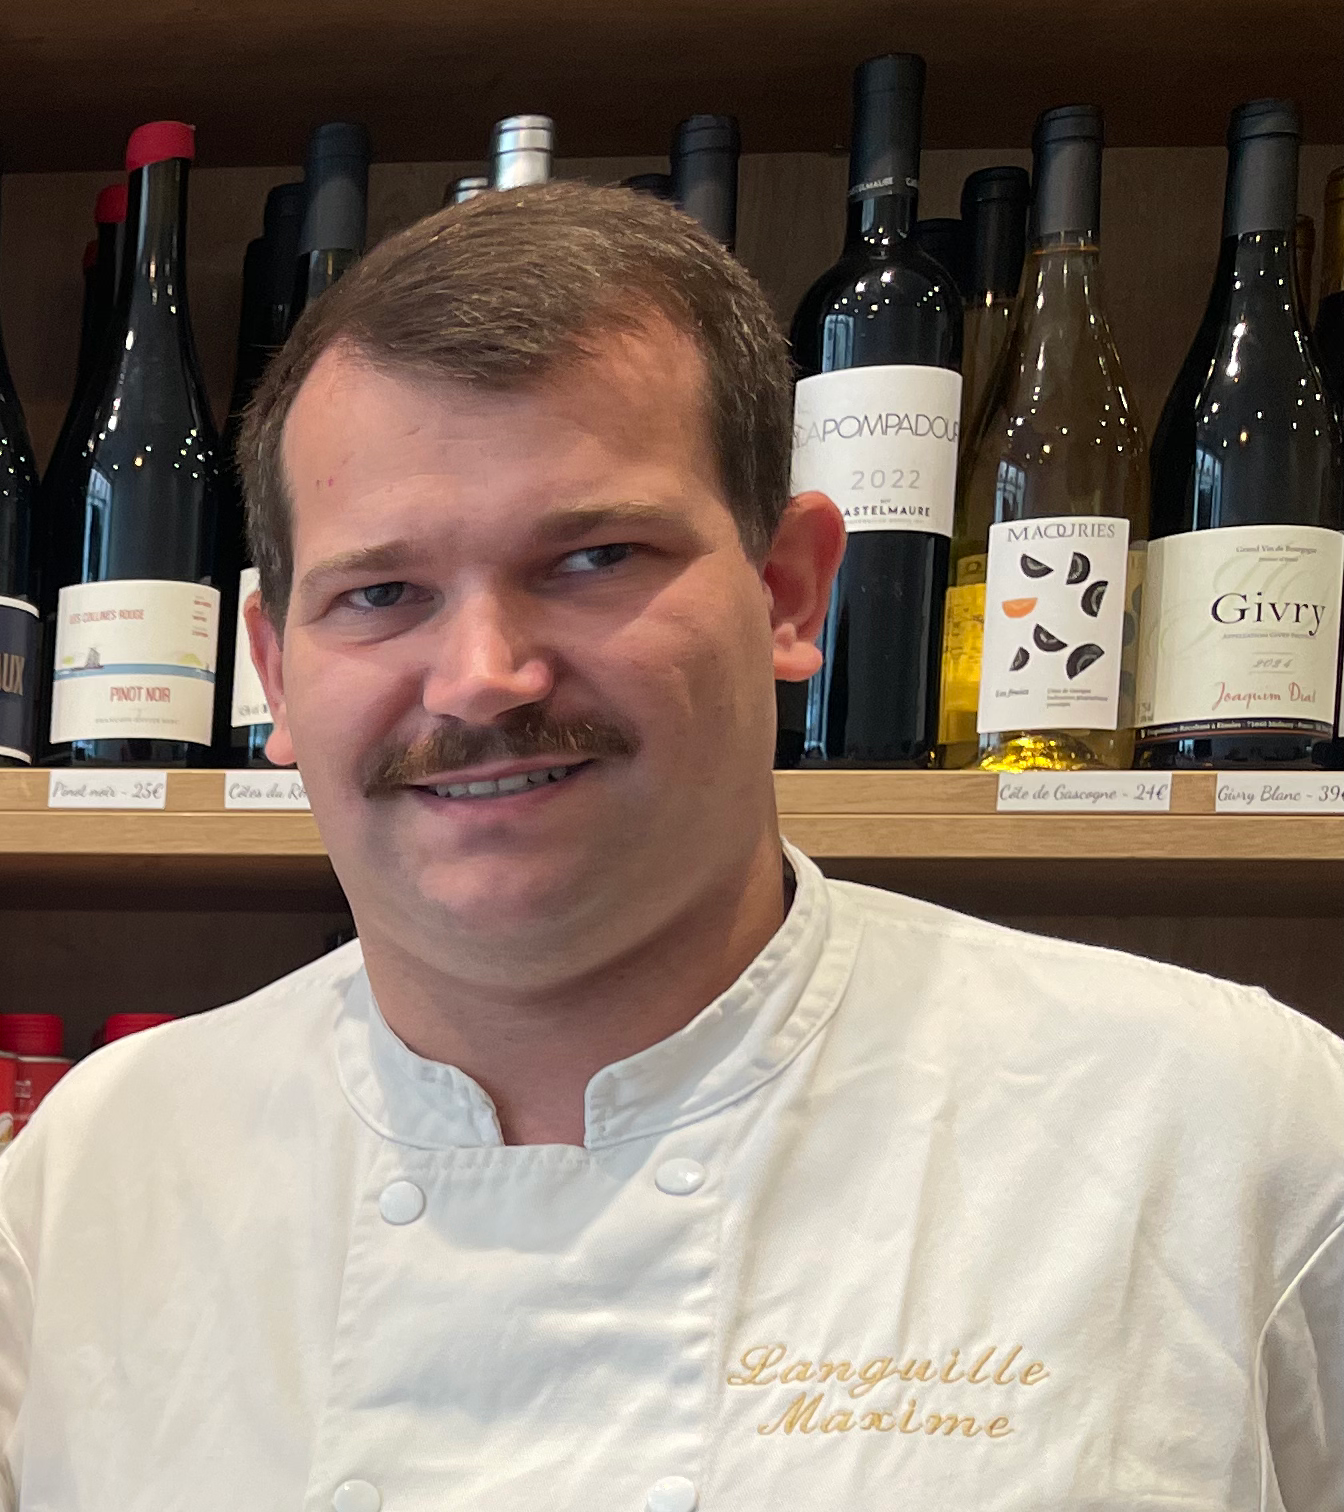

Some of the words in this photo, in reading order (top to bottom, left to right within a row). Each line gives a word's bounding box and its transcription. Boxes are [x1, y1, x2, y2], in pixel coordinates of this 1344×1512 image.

[851, 470, 921, 490] 2022
[844, 507, 930, 517] ASTELMAURE
[1211, 592, 1326, 636] Givry
[110, 686, 144, 702] PINOT
[146, 687, 171, 702] NOIR
[1212, 682, 1281, 710] Joaquim
[53, 781, 86, 798] Pinot
[133, 783, 164, 800] 25€
[1000, 783, 1029, 800] Côte
[1033, 784, 1050, 800] de
[1054, 783, 1117, 804] Gascogne
[1136, 784, 1168, 801] 24€
[1218, 785, 1255, 803] Givry
[1261, 784, 1301, 801] Blanc
[727, 1344, 1049, 1399] Languille
[757, 1391, 1014, 1438] Maxime
